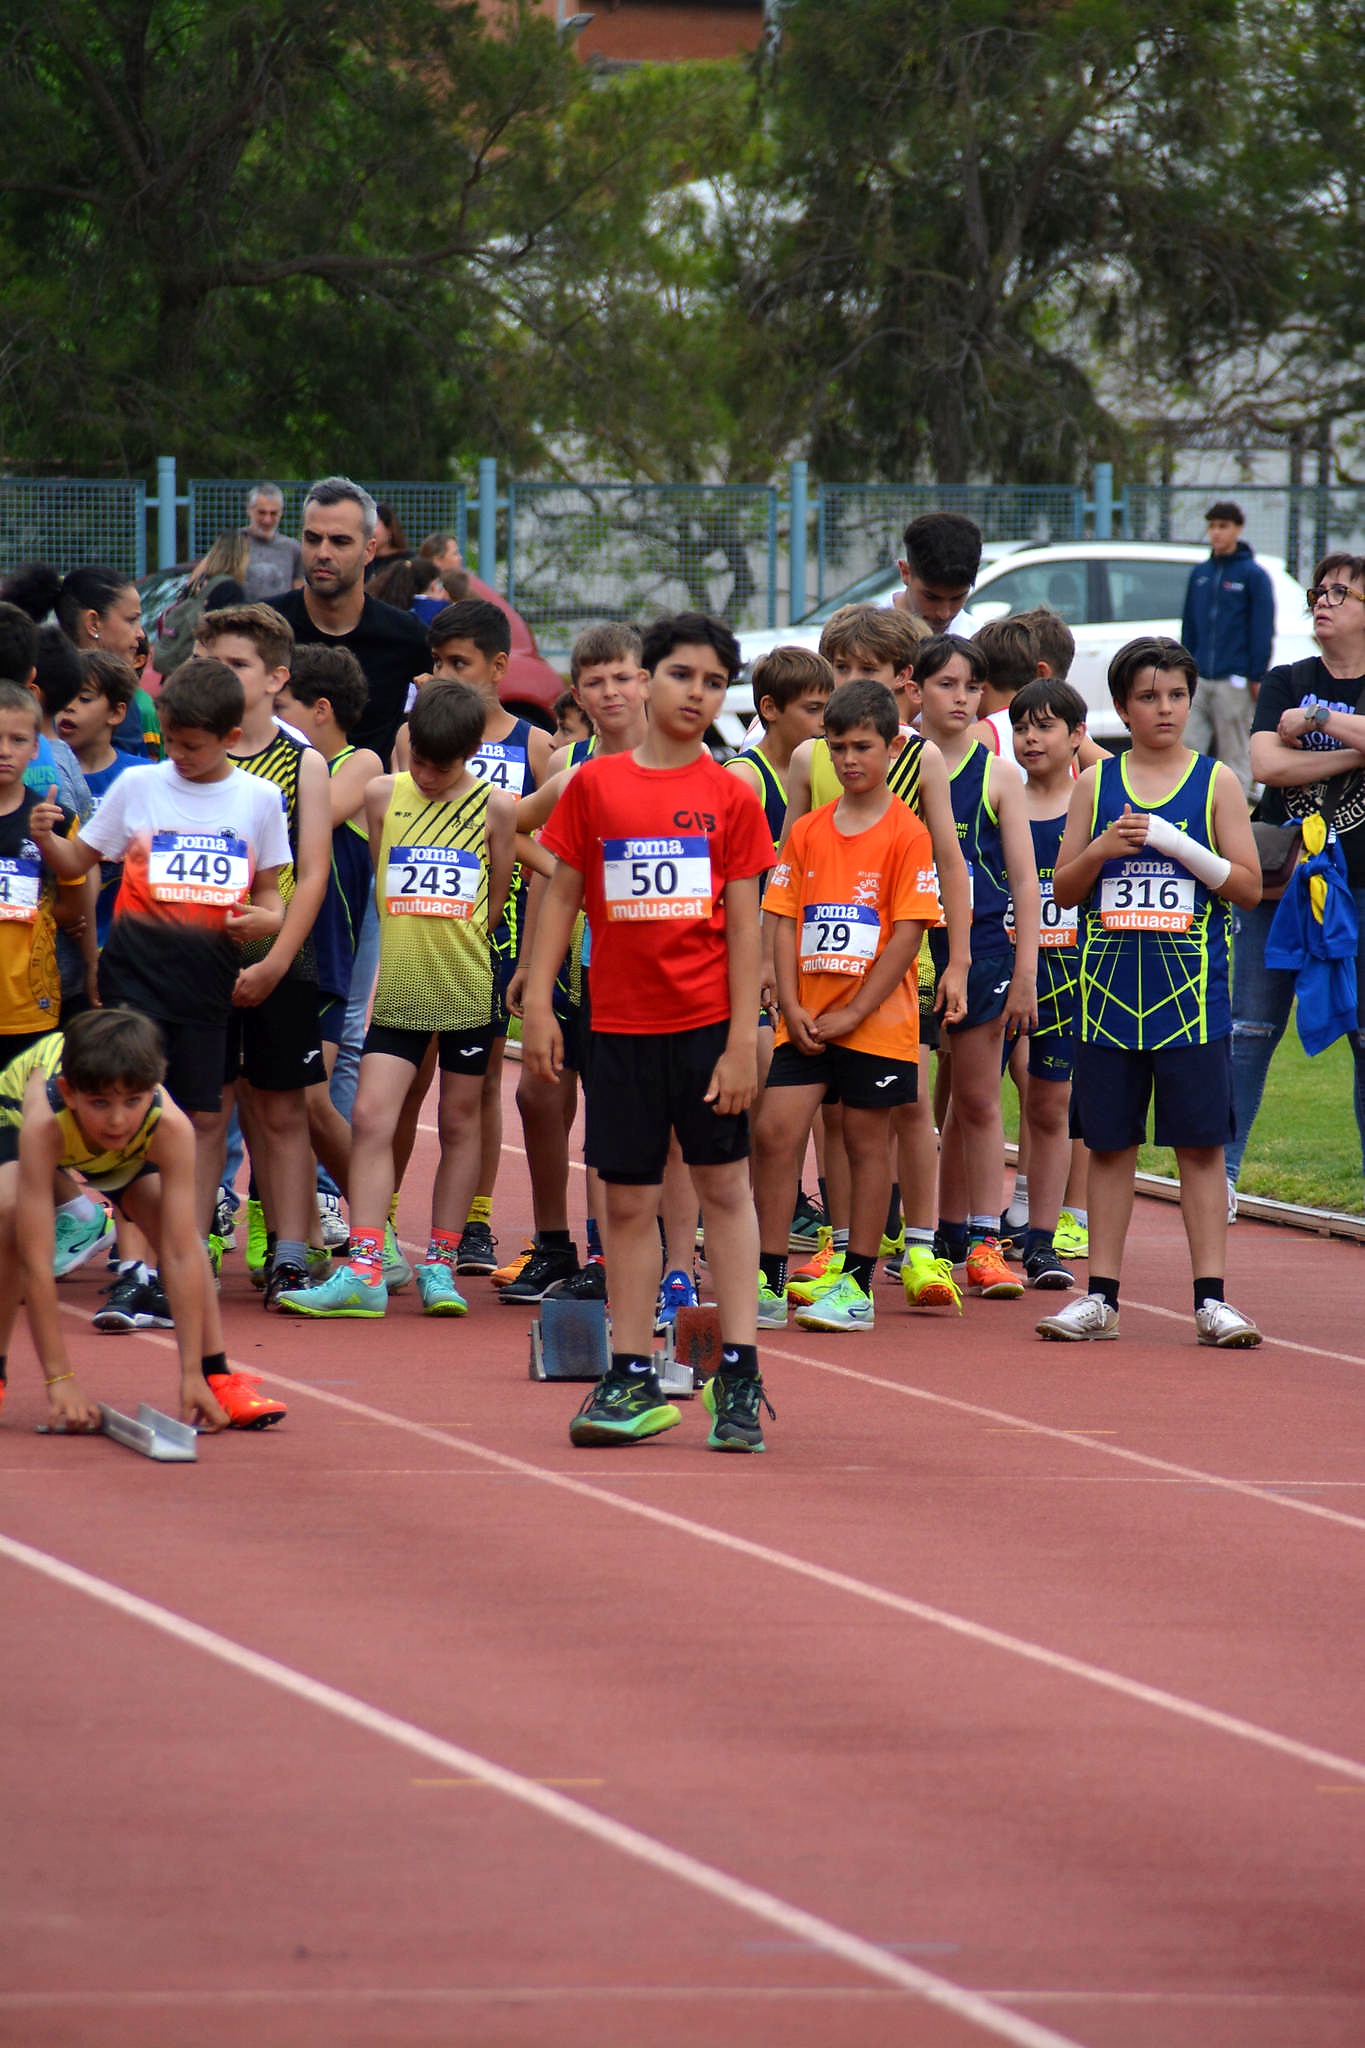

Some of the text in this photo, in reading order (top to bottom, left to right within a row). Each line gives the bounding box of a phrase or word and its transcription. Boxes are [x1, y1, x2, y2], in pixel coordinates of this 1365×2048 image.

[166, 853, 232, 885] 449
[400, 865, 462, 897] 243
[631, 860, 679, 897] 50
[156, 887, 241, 904] mutuacat
[1114, 879, 1179, 910] 316
[391, 899, 468, 918] mutuacat
[612, 899, 704, 919] mutuacat
[1105, 912, 1188, 930] mutuacat
[816, 923, 851, 952] 29
[802, 956, 867, 975] mutuacat
